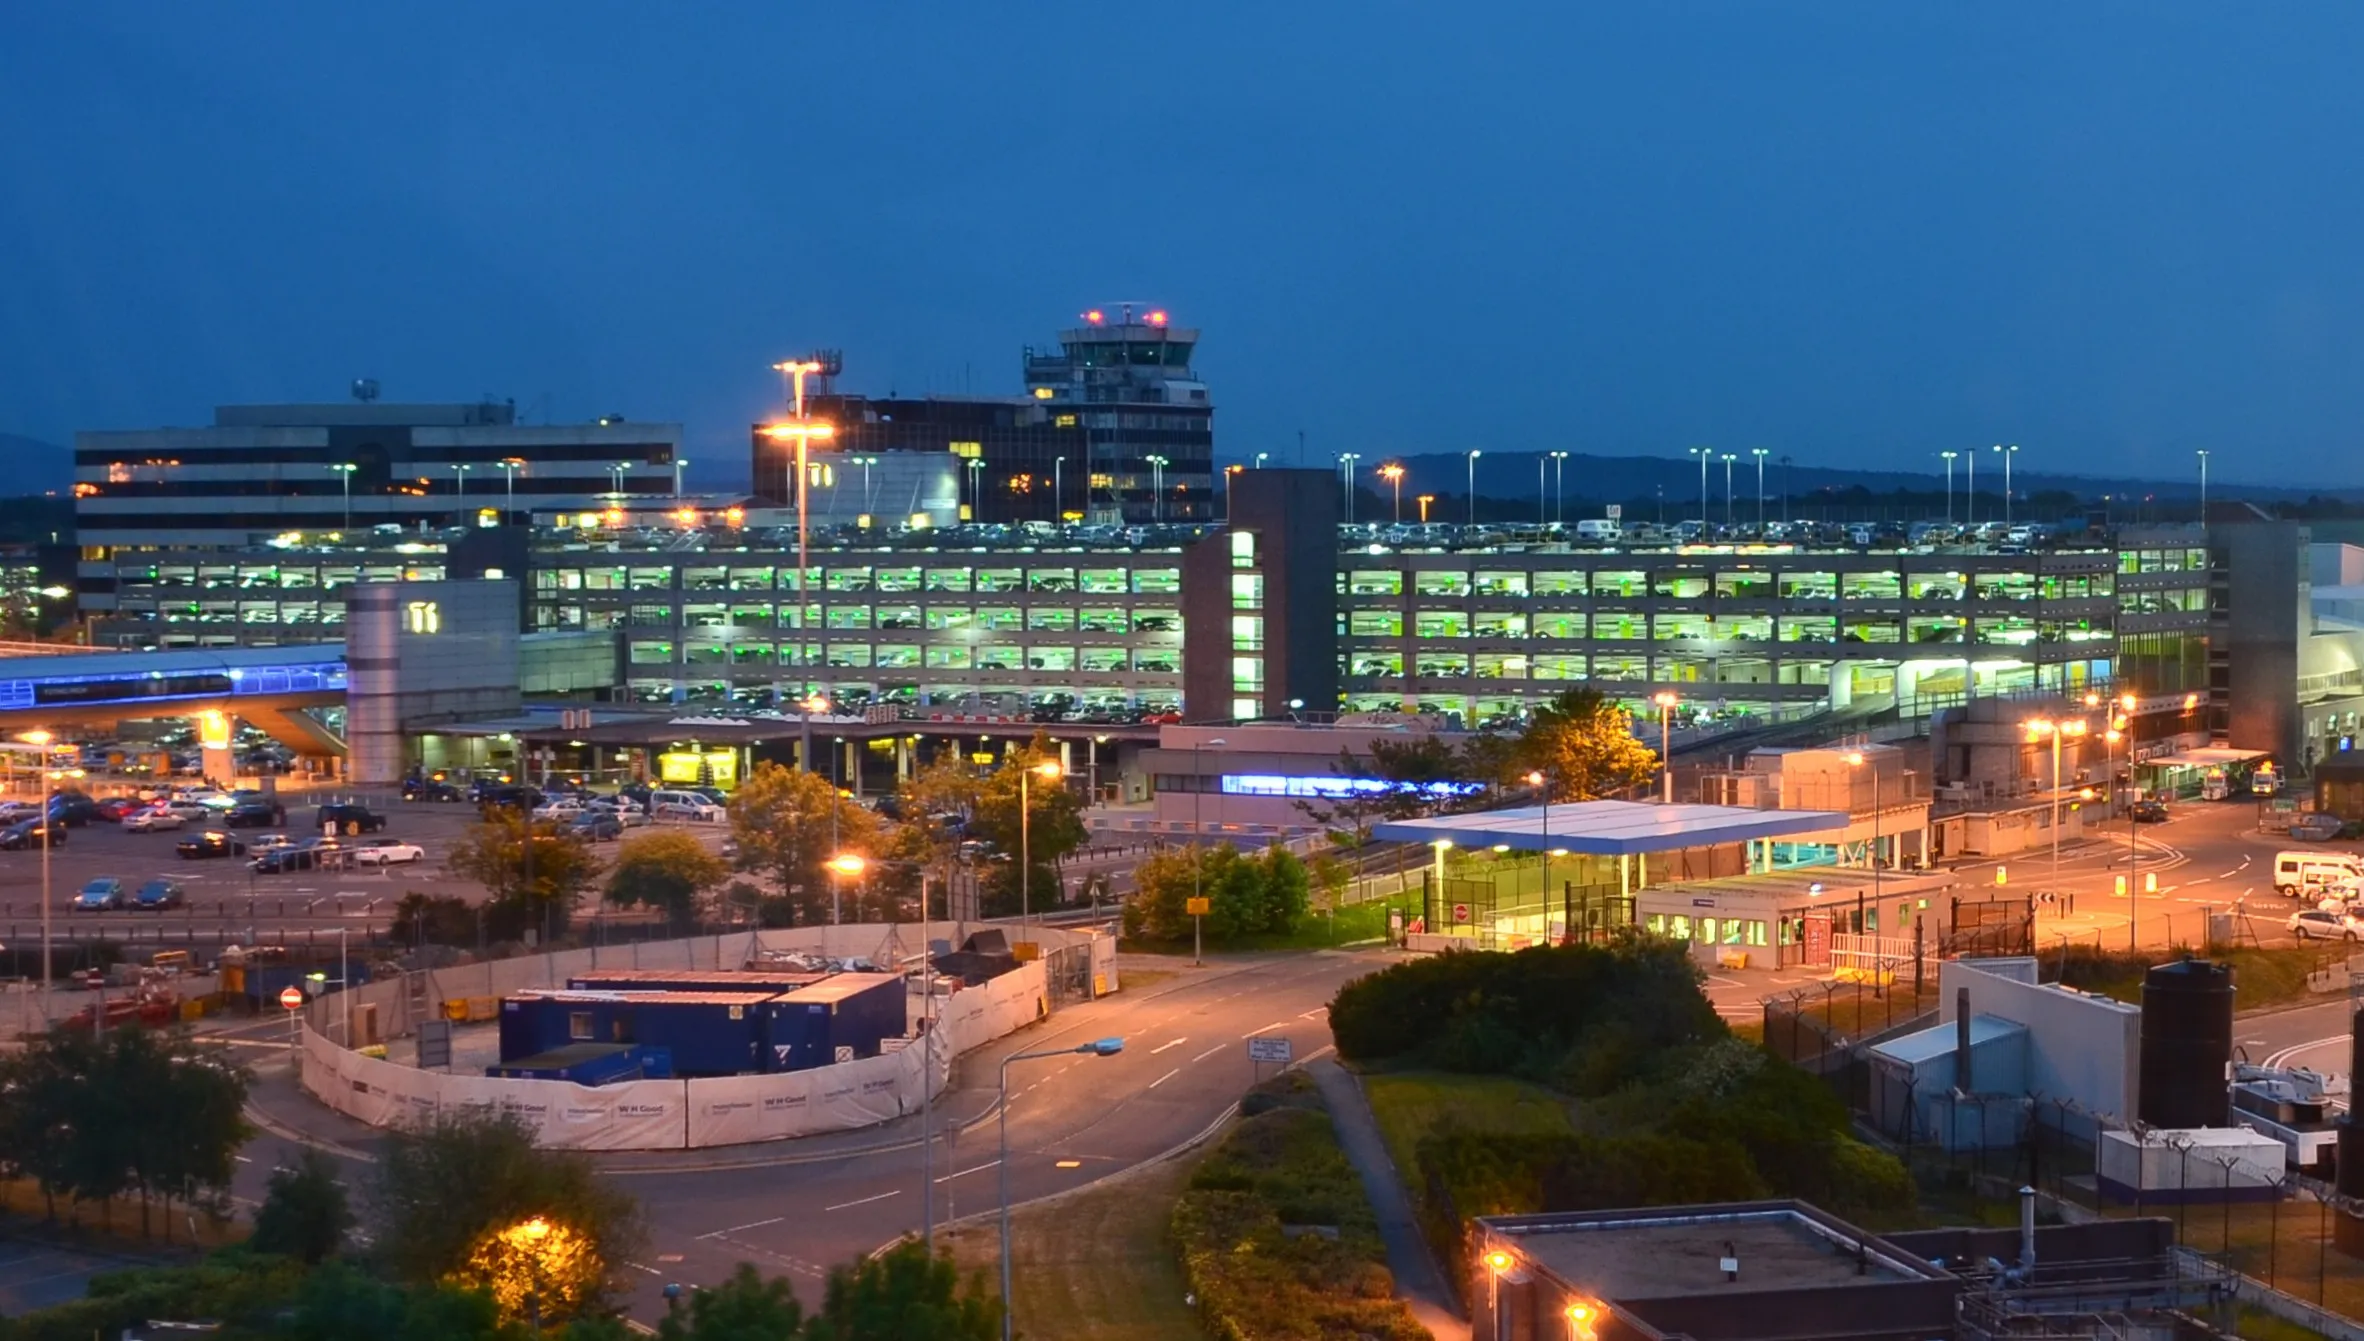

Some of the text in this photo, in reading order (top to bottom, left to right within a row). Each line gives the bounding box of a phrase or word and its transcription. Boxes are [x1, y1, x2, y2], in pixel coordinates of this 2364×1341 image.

[785, 1095, 806, 1104] Good
[524, 1103, 547, 1112] Good
[619, 1104, 663, 1113] W H Good
